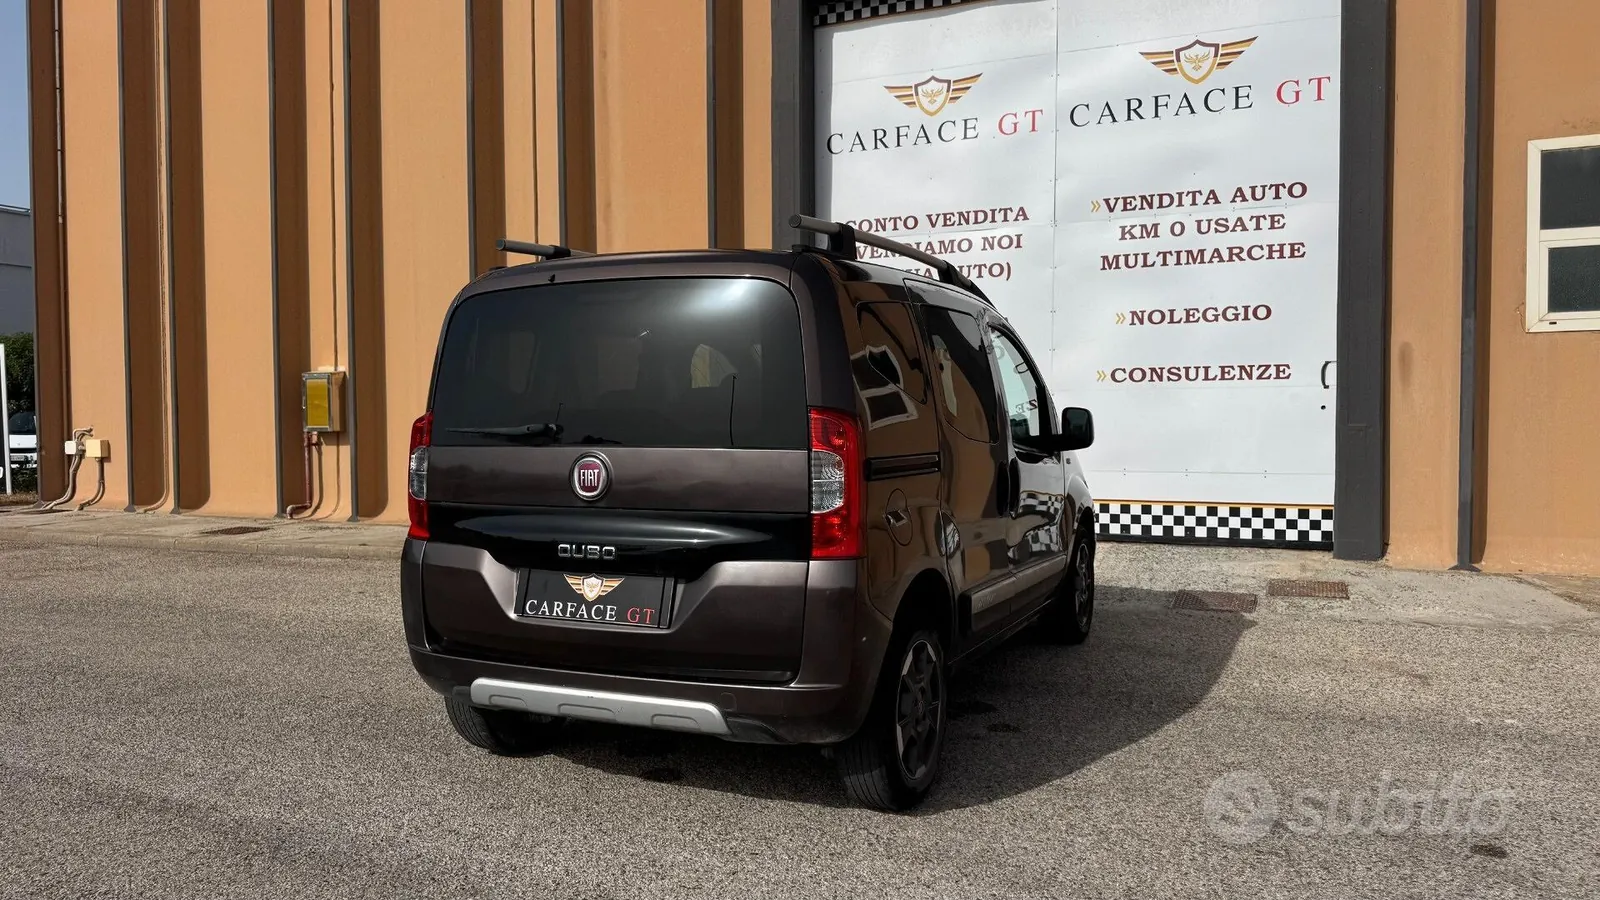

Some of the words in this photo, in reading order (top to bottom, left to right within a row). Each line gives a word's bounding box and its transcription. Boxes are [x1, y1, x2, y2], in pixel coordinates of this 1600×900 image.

[1069, 85, 1254, 127] CARFACE
[1276, 75, 1332, 106] GT
[826, 117, 979, 155] CARFACE
[997, 109, 1044, 136] GT
[1103, 189, 1222, 213] VENDITA
[1230, 181, 1308, 203] AUTO
[926, 206, 1030, 229] VENDITA
[1118, 222, 1161, 241] KM
[1195, 213, 1287, 235] USATE
[981, 233, 1023, 251] NOI
[1100, 242, 1307, 271] MULTIMARCHE
[1129, 304, 1273, 326] NOLEGGIO
[1110, 363, 1292, 383] CONSULENZE
[580, 469, 600, 487] FIAT
[558, 543, 616, 560] QUBO
[525, 600, 617, 622] CARFACE
[626, 607, 655, 625] GT
